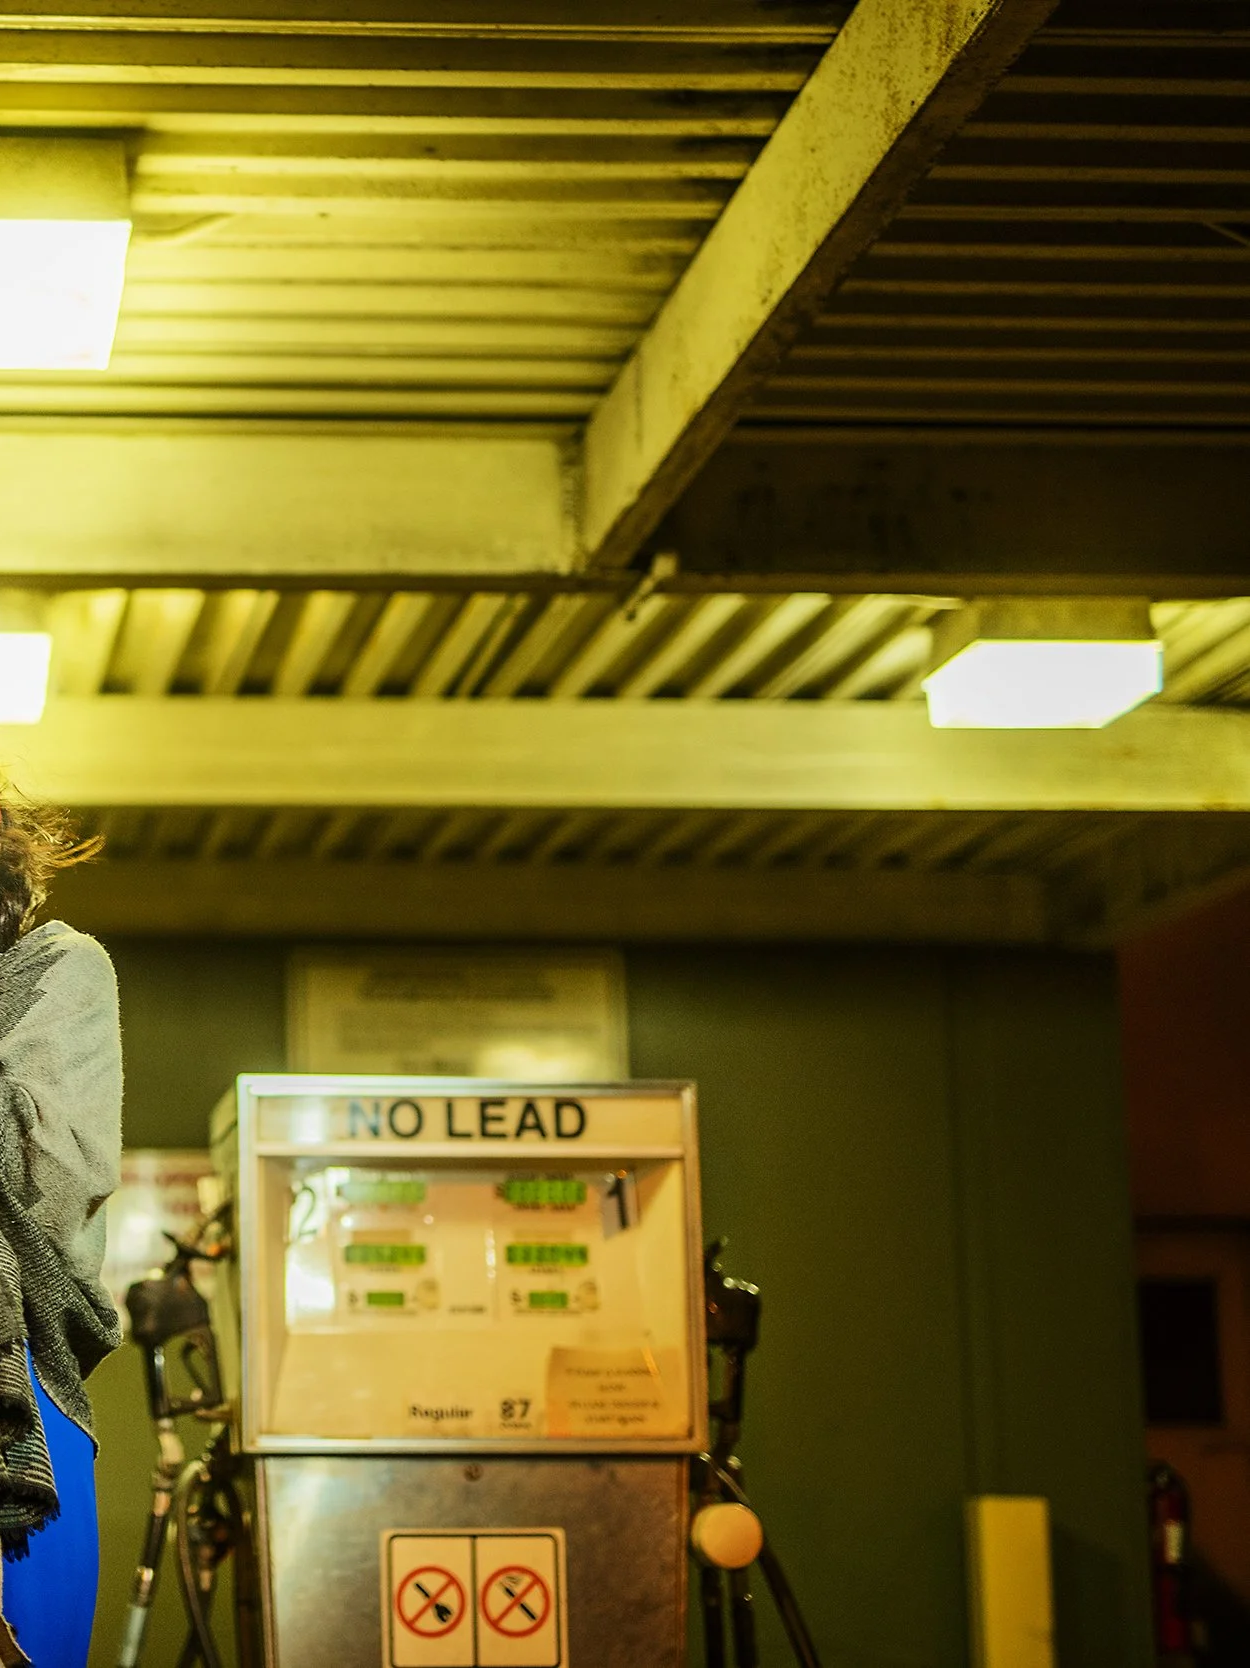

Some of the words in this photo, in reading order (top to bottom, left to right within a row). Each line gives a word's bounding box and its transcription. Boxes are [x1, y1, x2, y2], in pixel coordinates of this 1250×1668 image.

[348, 1098, 423, 1139] NO
[447, 1097, 587, 1140] LEAD
[298, 1185, 318, 1236] 2
[607, 1177, 629, 1230] 1
[409, 1404, 473, 1422] Regular
[500, 1397, 531, 1420] 87
